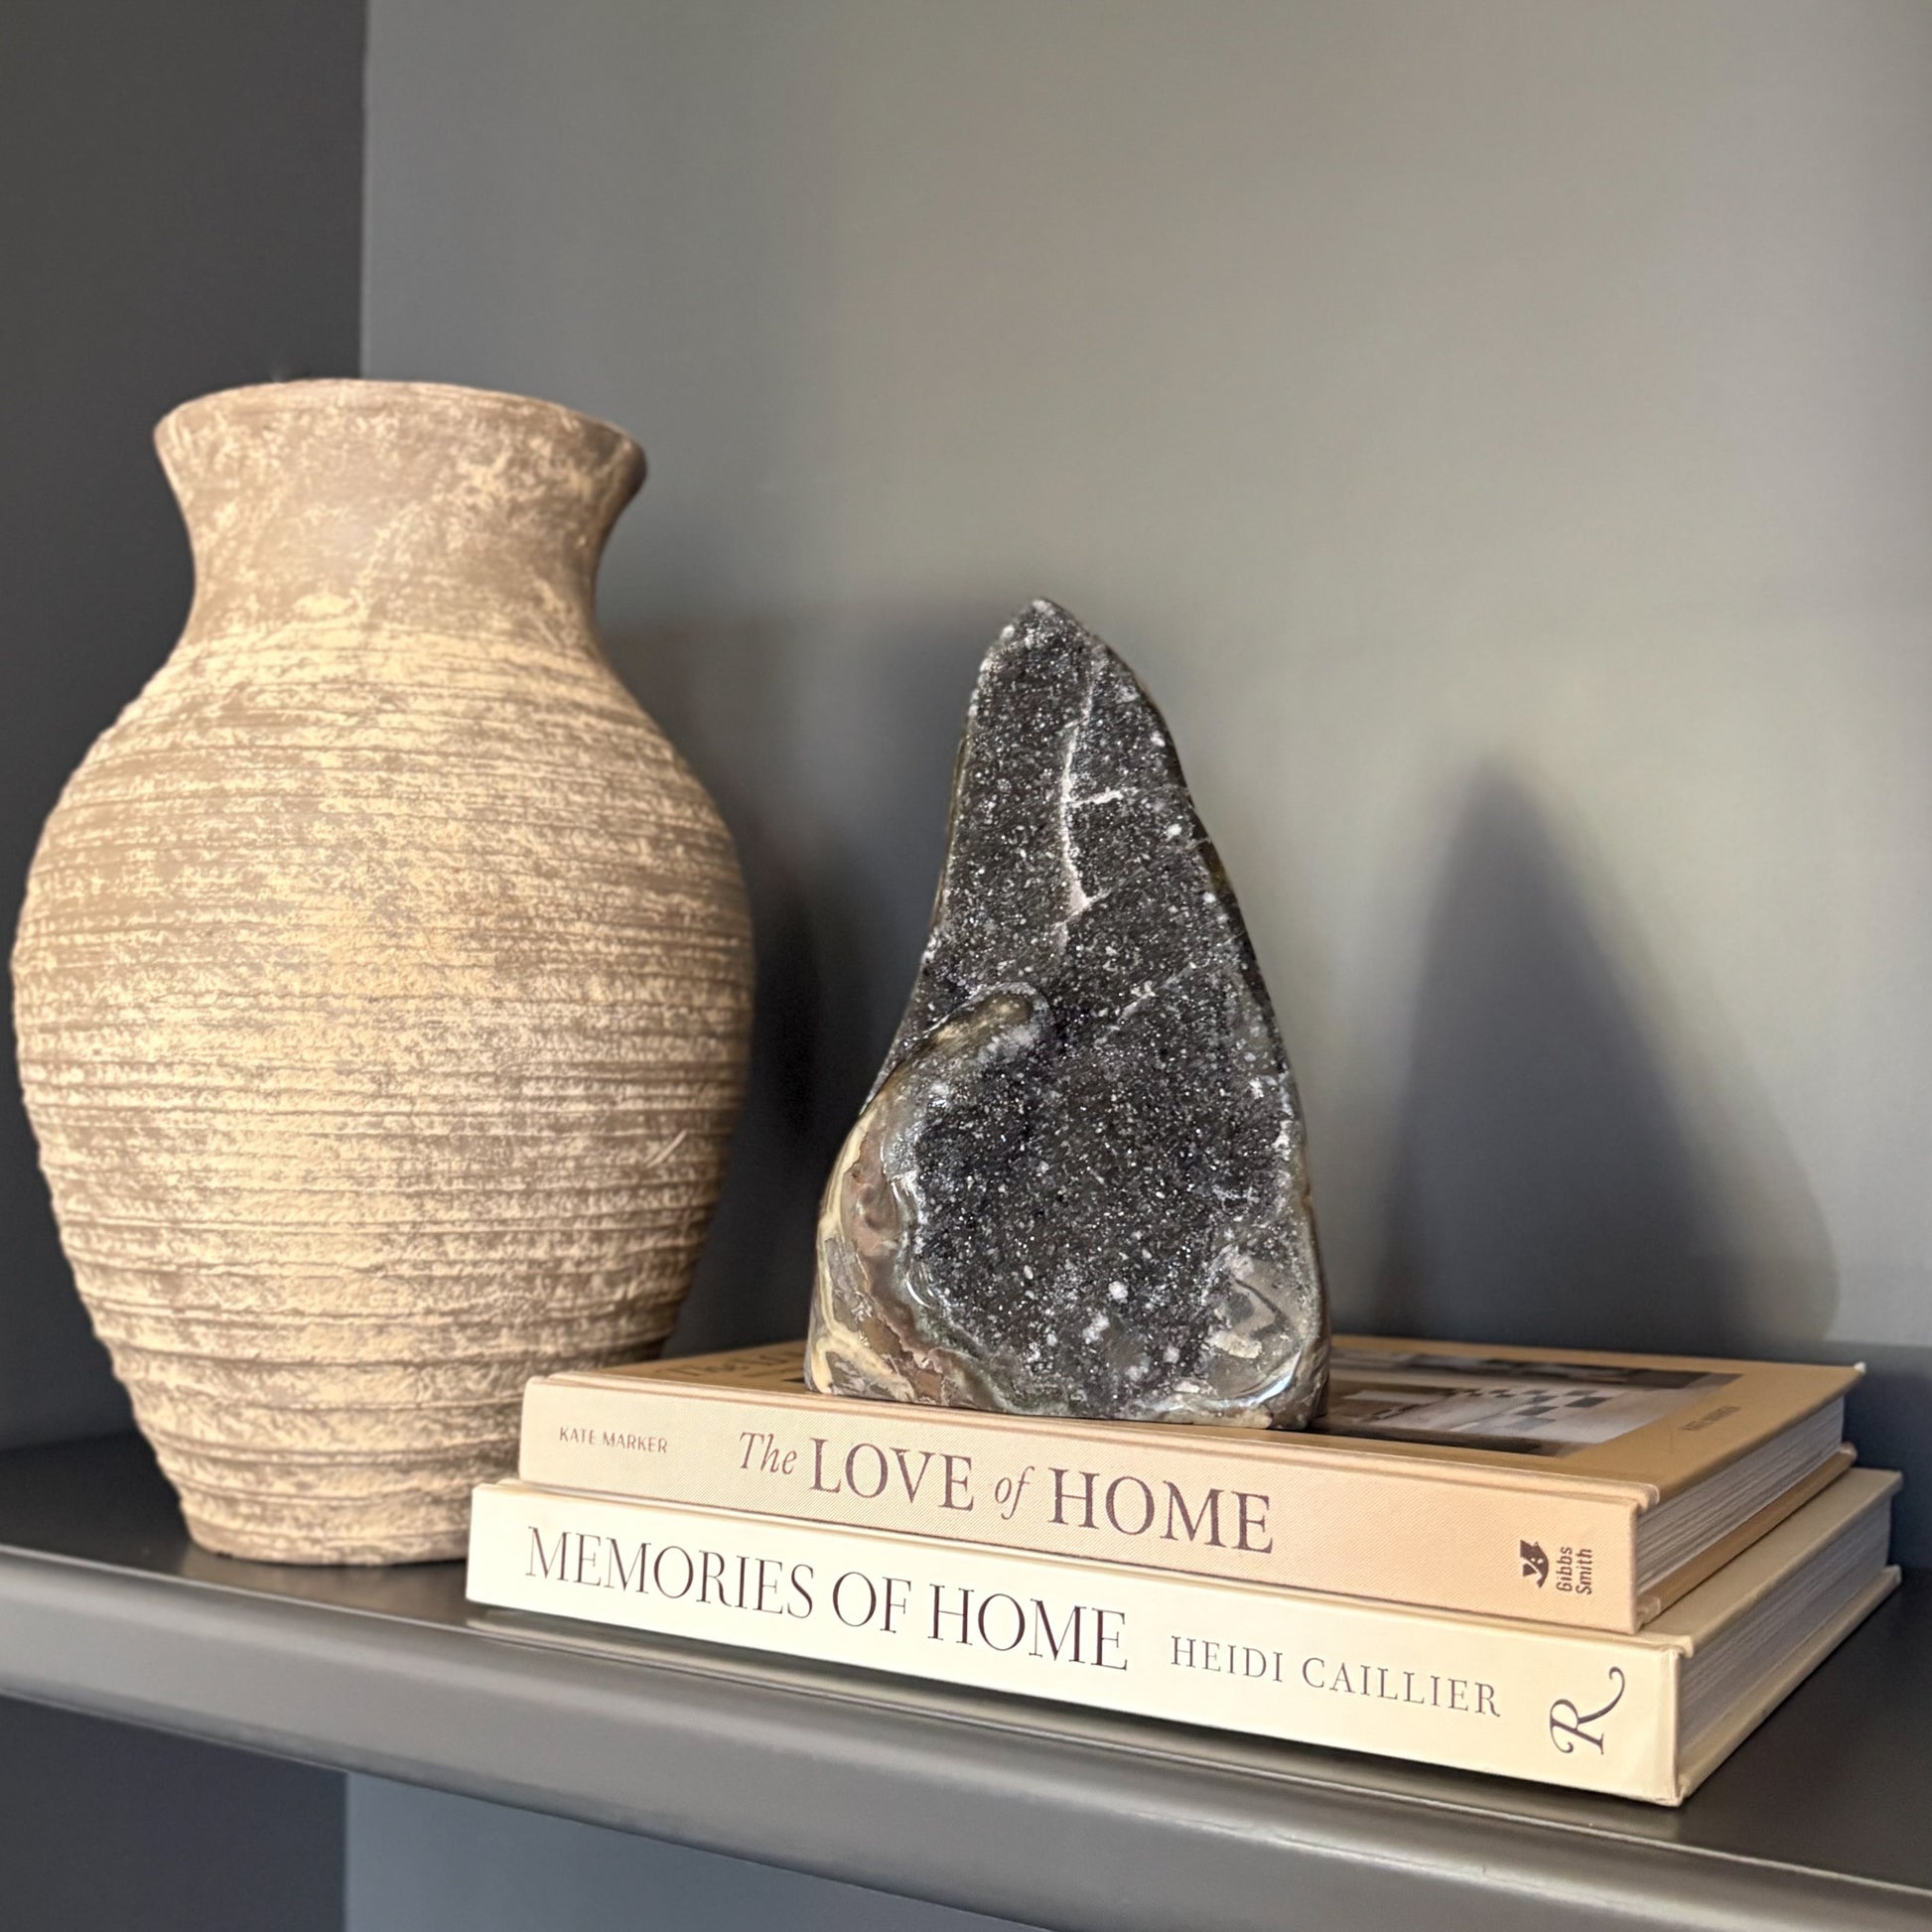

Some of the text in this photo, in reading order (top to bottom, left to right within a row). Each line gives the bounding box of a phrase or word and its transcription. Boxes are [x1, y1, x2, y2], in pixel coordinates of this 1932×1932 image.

[558, 1426, 668, 1453] KATE MARKER
[740, 1432, 1274, 1555] The LOVE of HOME
[525, 1525, 1129, 1672] MEMORIES OF HOME
[1556, 1546, 1573, 1592] Gibbs
[1575, 1548, 1592, 1595] Smith
[1170, 1634, 1502, 1718] HEIDI CAILLIER
